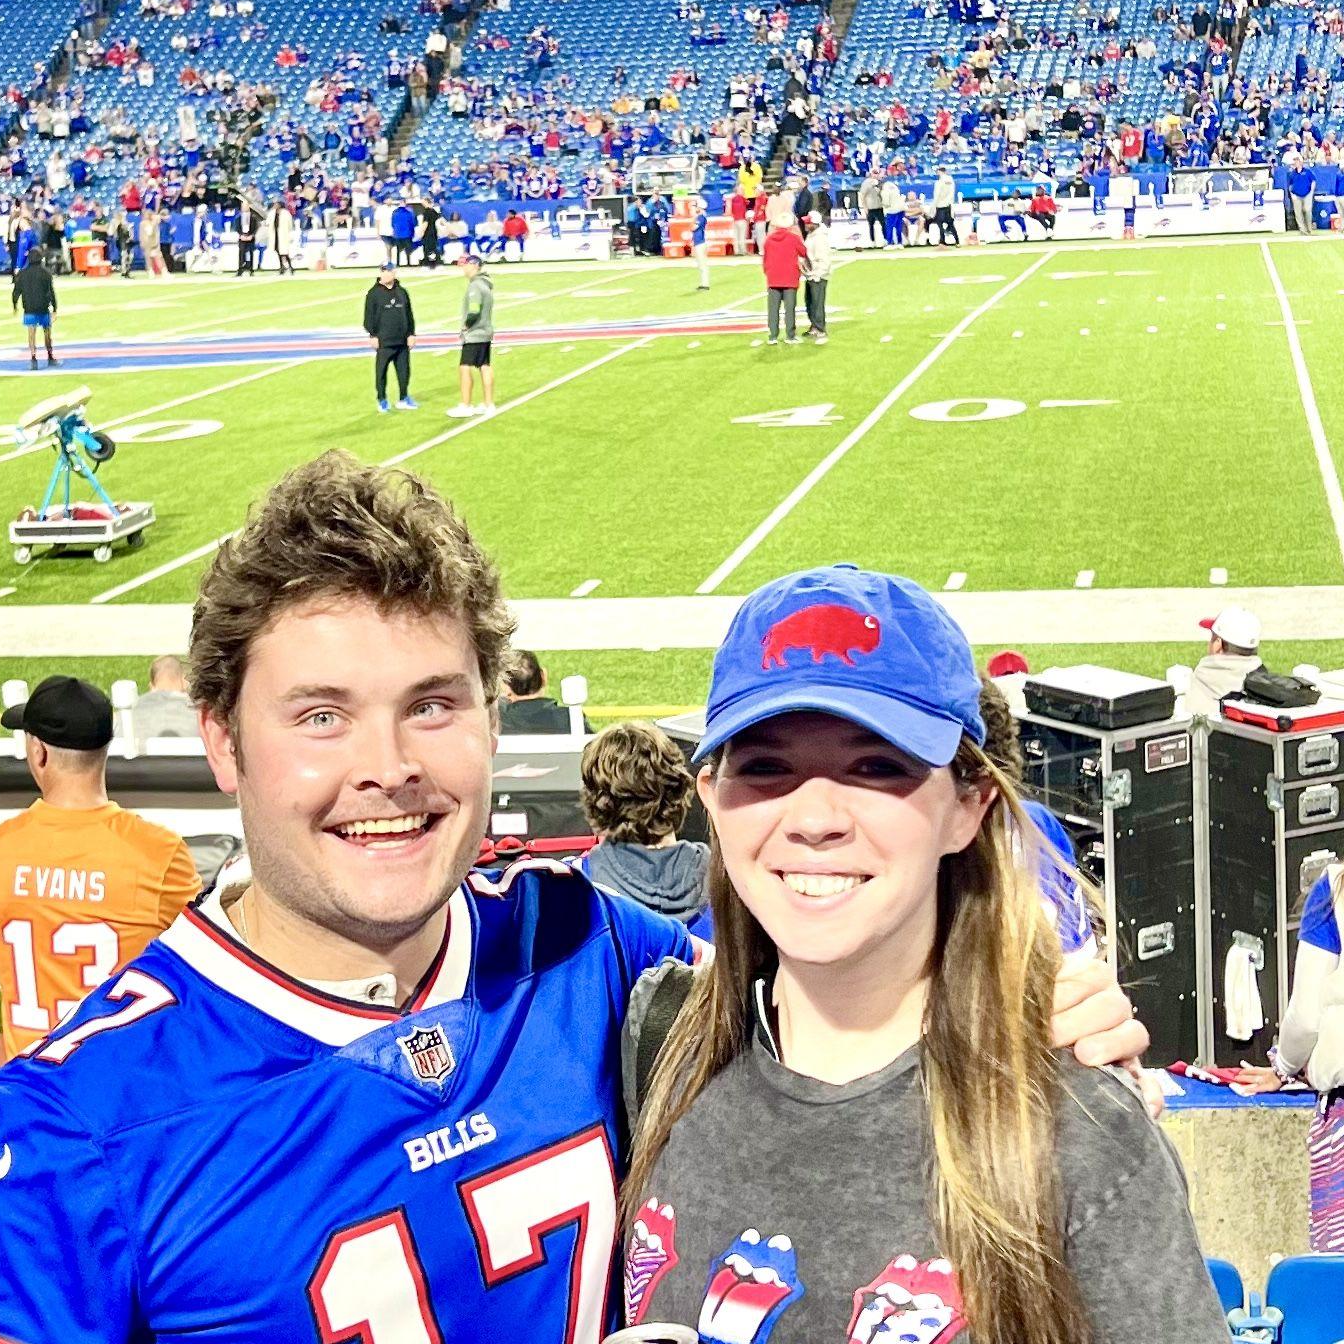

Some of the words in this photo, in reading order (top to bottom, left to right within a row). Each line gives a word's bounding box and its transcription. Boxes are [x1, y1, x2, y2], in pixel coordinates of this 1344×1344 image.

[13, 864, 106, 903] EVANS
[2, 918, 120, 1032] 13
[416, 1047, 448, 1075] NFL
[403, 1112, 497, 1173] BILLS
